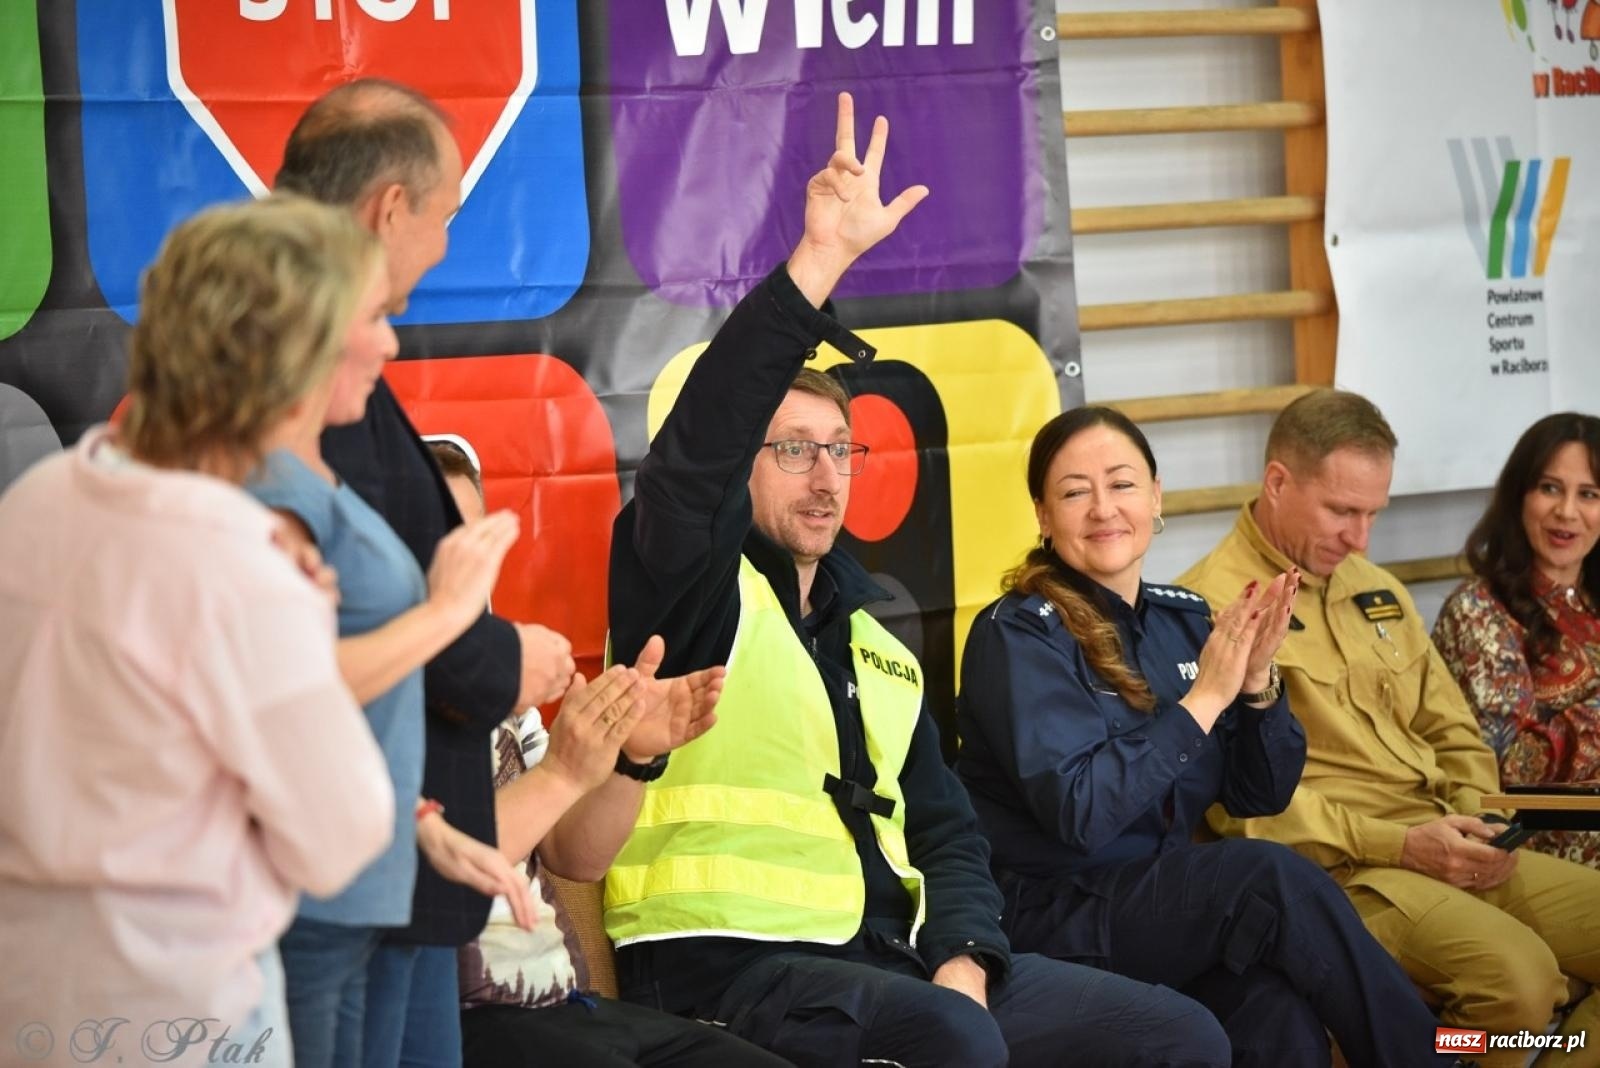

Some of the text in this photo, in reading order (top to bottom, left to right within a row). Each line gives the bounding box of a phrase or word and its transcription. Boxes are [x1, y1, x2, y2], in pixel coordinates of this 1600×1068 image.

[1487, 288, 1543, 304] Powiatowe
[1487, 312, 1533, 328] Centrum
[1489, 336, 1524, 354] Sportu
[1491, 364, 1500, 375] w
[860, 647, 919, 688] POLICJA
